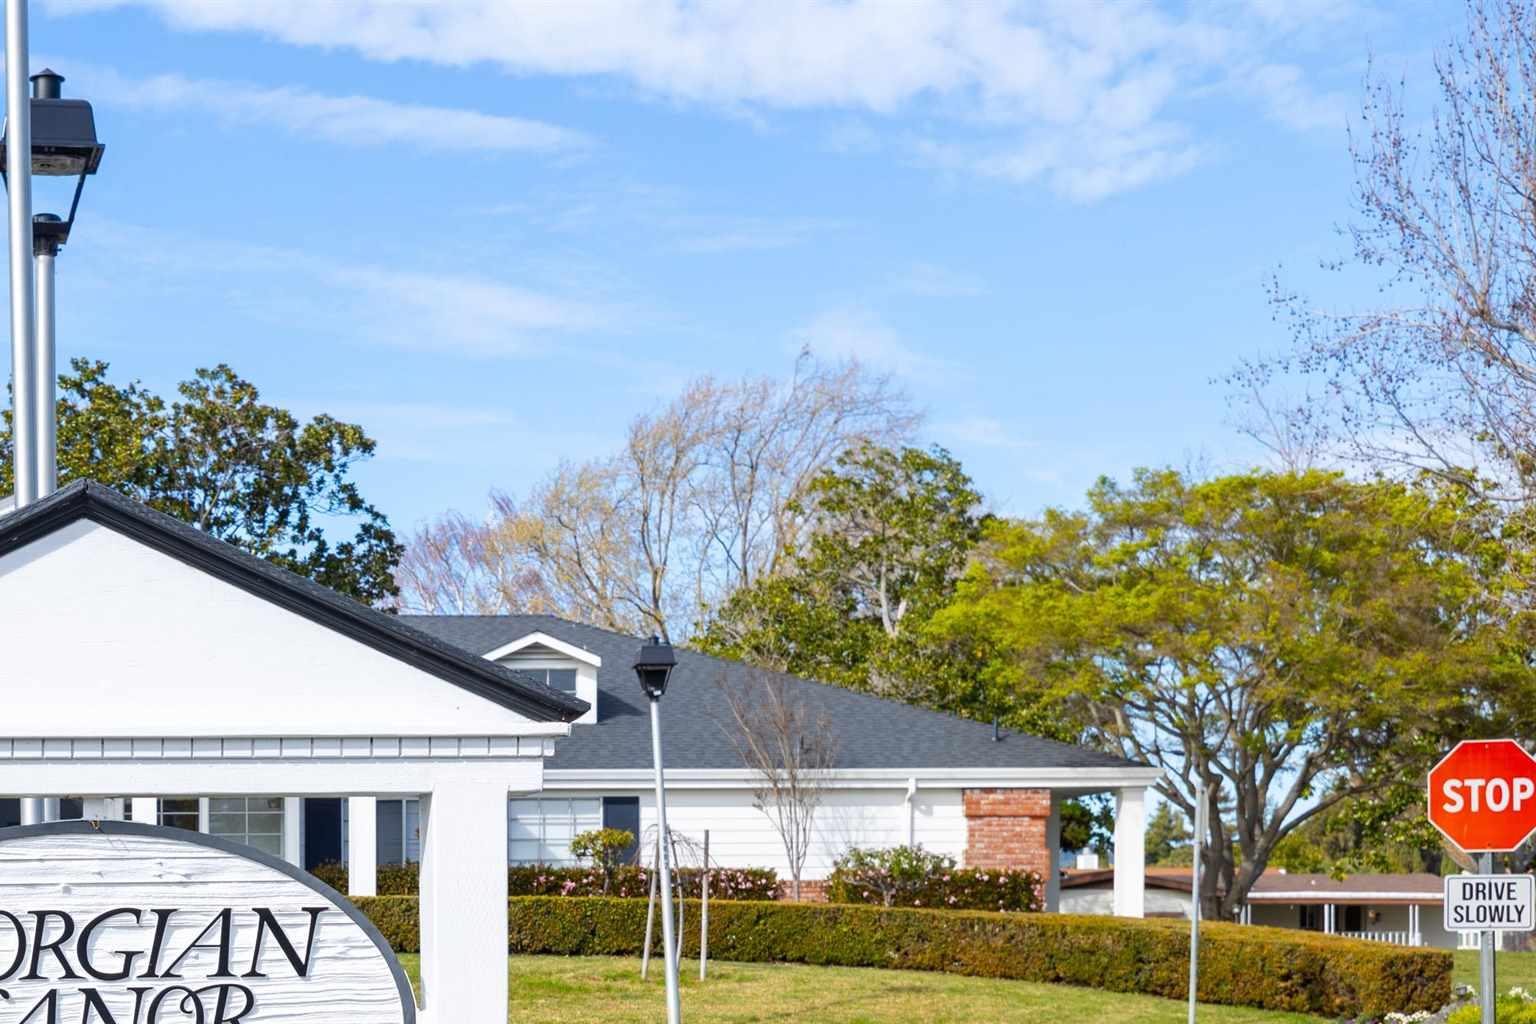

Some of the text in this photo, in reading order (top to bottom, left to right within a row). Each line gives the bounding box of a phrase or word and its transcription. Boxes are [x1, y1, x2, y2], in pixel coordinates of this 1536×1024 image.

[1442, 777, 1535, 813] STOP
[1462, 881, 1517, 901] DRIVE
[1453, 904, 1525, 924] SLOWLY
